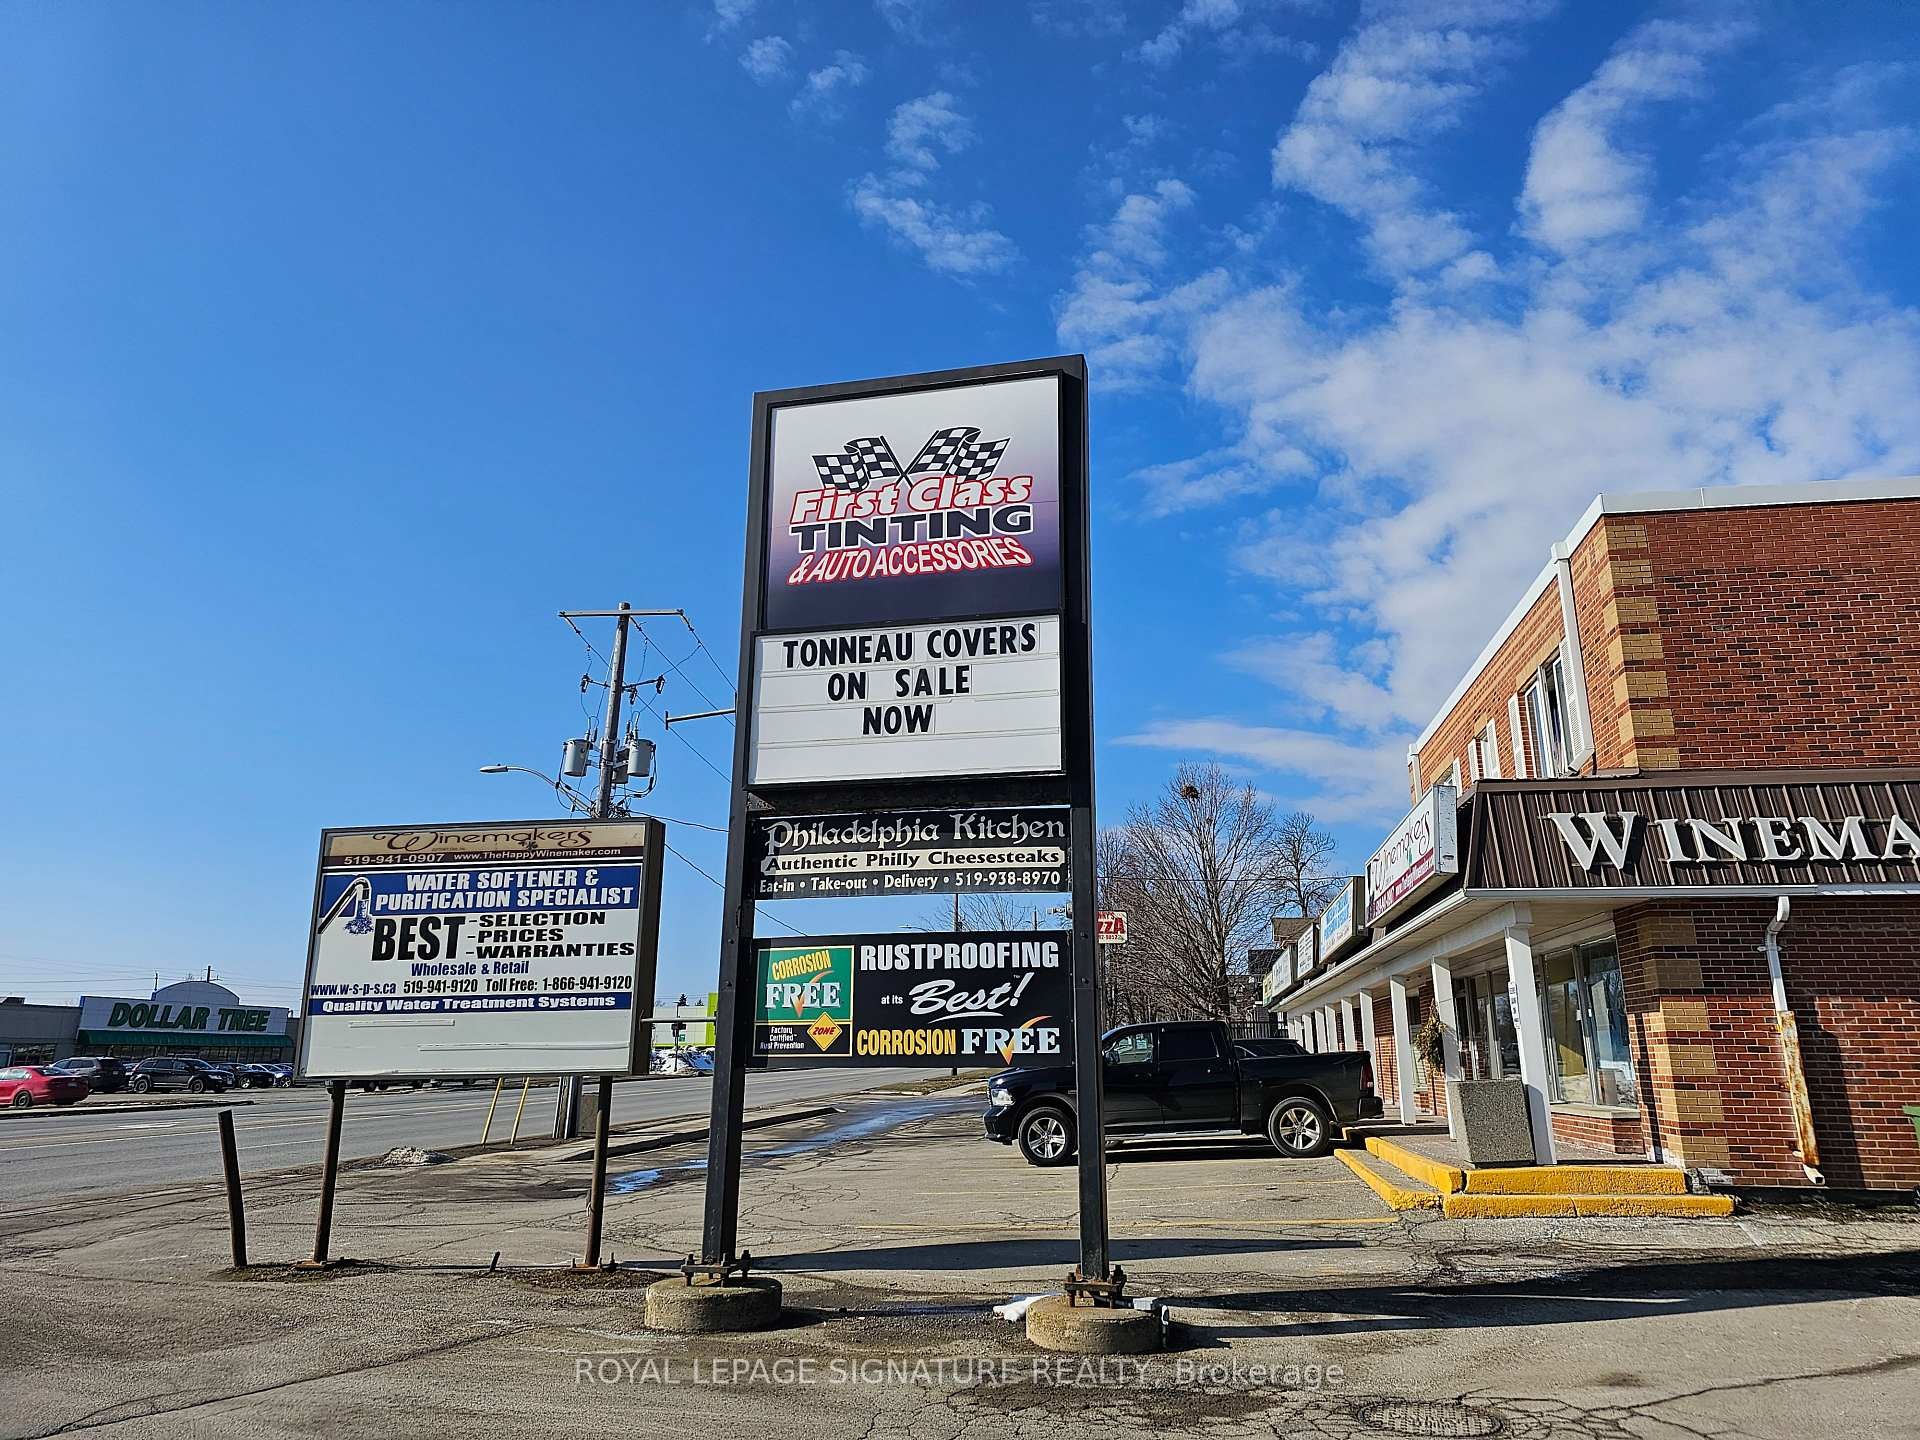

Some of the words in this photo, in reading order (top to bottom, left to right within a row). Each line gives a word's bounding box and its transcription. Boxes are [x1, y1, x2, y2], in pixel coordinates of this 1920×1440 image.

[789, 483, 901, 524] First
[909, 475, 1034, 509] Class
[789, 505, 1034, 553] TINTING
[787, 555, 811, 584] &
[807, 549, 872, 582] AUTO
[871, 538, 1033, 577] ACCESSORIES
[783, 632, 913, 668] TONNEAU
[927, 624, 1036, 659] COVERS
[828, 672, 867, 701] ON
[896, 665, 970, 697] SALE
[863, 704, 933, 735] NOW
[372, 828, 593, 851] Winemakers
[762, 819, 940, 855] Philadelphia
[950, 813, 1066, 844] Kitchen
[343, 853, 445, 866] 519-941-0907
[454, 848, 622, 861] www.TheHappyWinemaker.com
[766, 855, 858, 872] Authentic
[866, 851, 920, 868] Philly
[928, 849, 1060, 865] Cheesesteaks
[406, 873, 470, 891] WATER
[477, 870, 578, 888] SOFTENER
[585, 869, 599, 885] &
[760, 879, 795, 893] Eat-in
[811, 876, 867, 891] Take-out
[884, 873, 938, 889] Delivery
[955, 871, 1061, 886] 519-938-8970
[375, 891, 513, 911] PURIFICATION
[517, 887, 634, 907] SPECIALIST
[371, 916, 465, 962] BEST
[411, 962, 477, 977] Wholesale
[481, 963, 490, 975] &
[493, 961, 529, 974] Retail
[772, 950, 832, 980] CORROSION
[860, 941, 1059, 971] RUSTPROOFING
[311, 983, 397, 996] www.w-s-p-s.ca
[403, 979, 478, 994] 519-941-9120
[486, 978, 507, 992] Toll
[509, 977, 538, 991] Free:
[542, 975, 632, 991] 1-866-941-9120
[765, 981, 842, 1010] FREE
[881, 996, 891, 1005] at
[892, 995, 903, 1005] its
[909, 972, 1034, 1014] Best!
[108, 1002, 211, 1030] DOLLAR
[218, 1008, 271, 1031] TREE
[322, 1000, 383, 1013] Quality
[386, 1000, 439, 1011] Water
[443, 998, 535, 1010] Treatment
[538, 996, 616, 1008] Systems
[771, 1026, 793, 1034] Factory
[812, 1027, 836, 1035] ZONE
[856, 1028, 956, 1056] CORROSION
[961, 1027, 1061, 1054] FREE
[773, 1041, 805, 1049] Prevention
